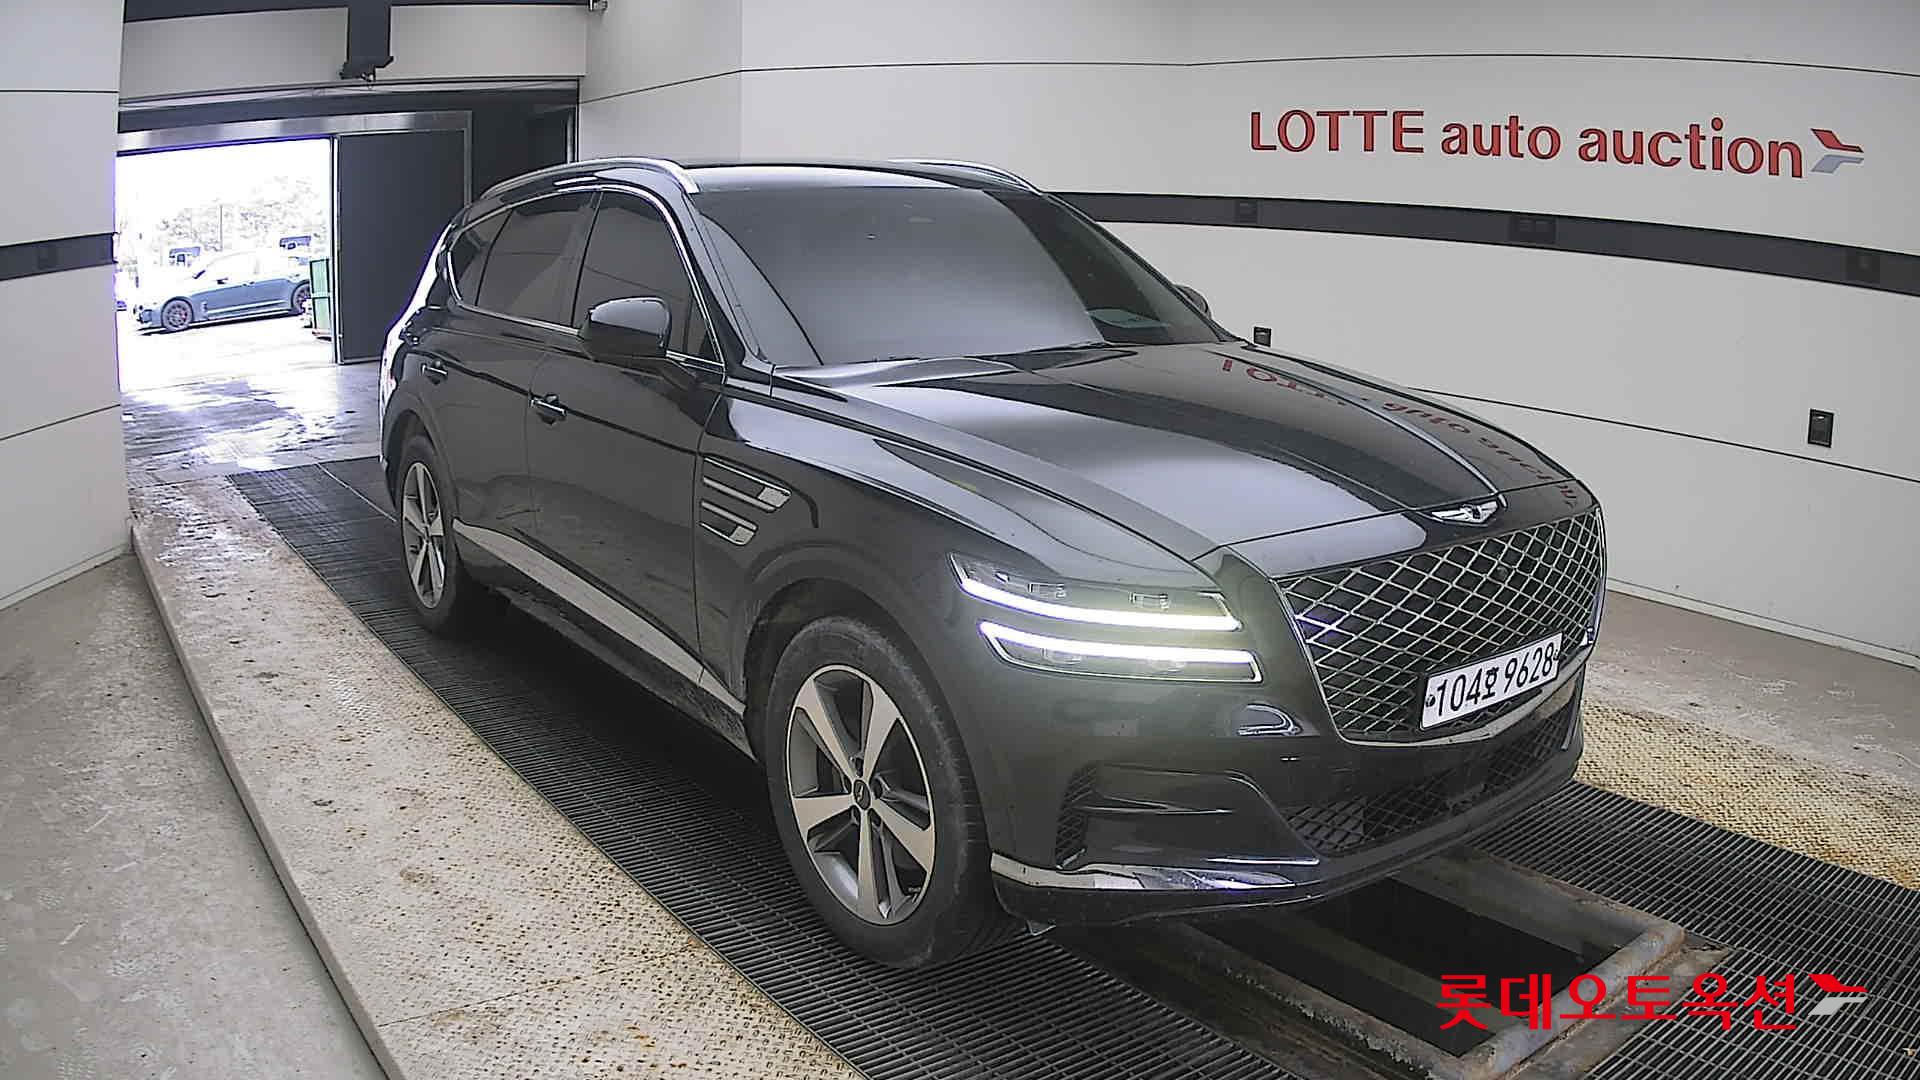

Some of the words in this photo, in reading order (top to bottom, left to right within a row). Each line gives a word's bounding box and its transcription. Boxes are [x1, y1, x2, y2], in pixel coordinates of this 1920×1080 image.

[1250, 110, 1425, 153] LOTTE
[1441, 115, 1562, 160] auto
[1577, 117, 1803, 178] auction
[1504, 642, 1555, 694] 9628
